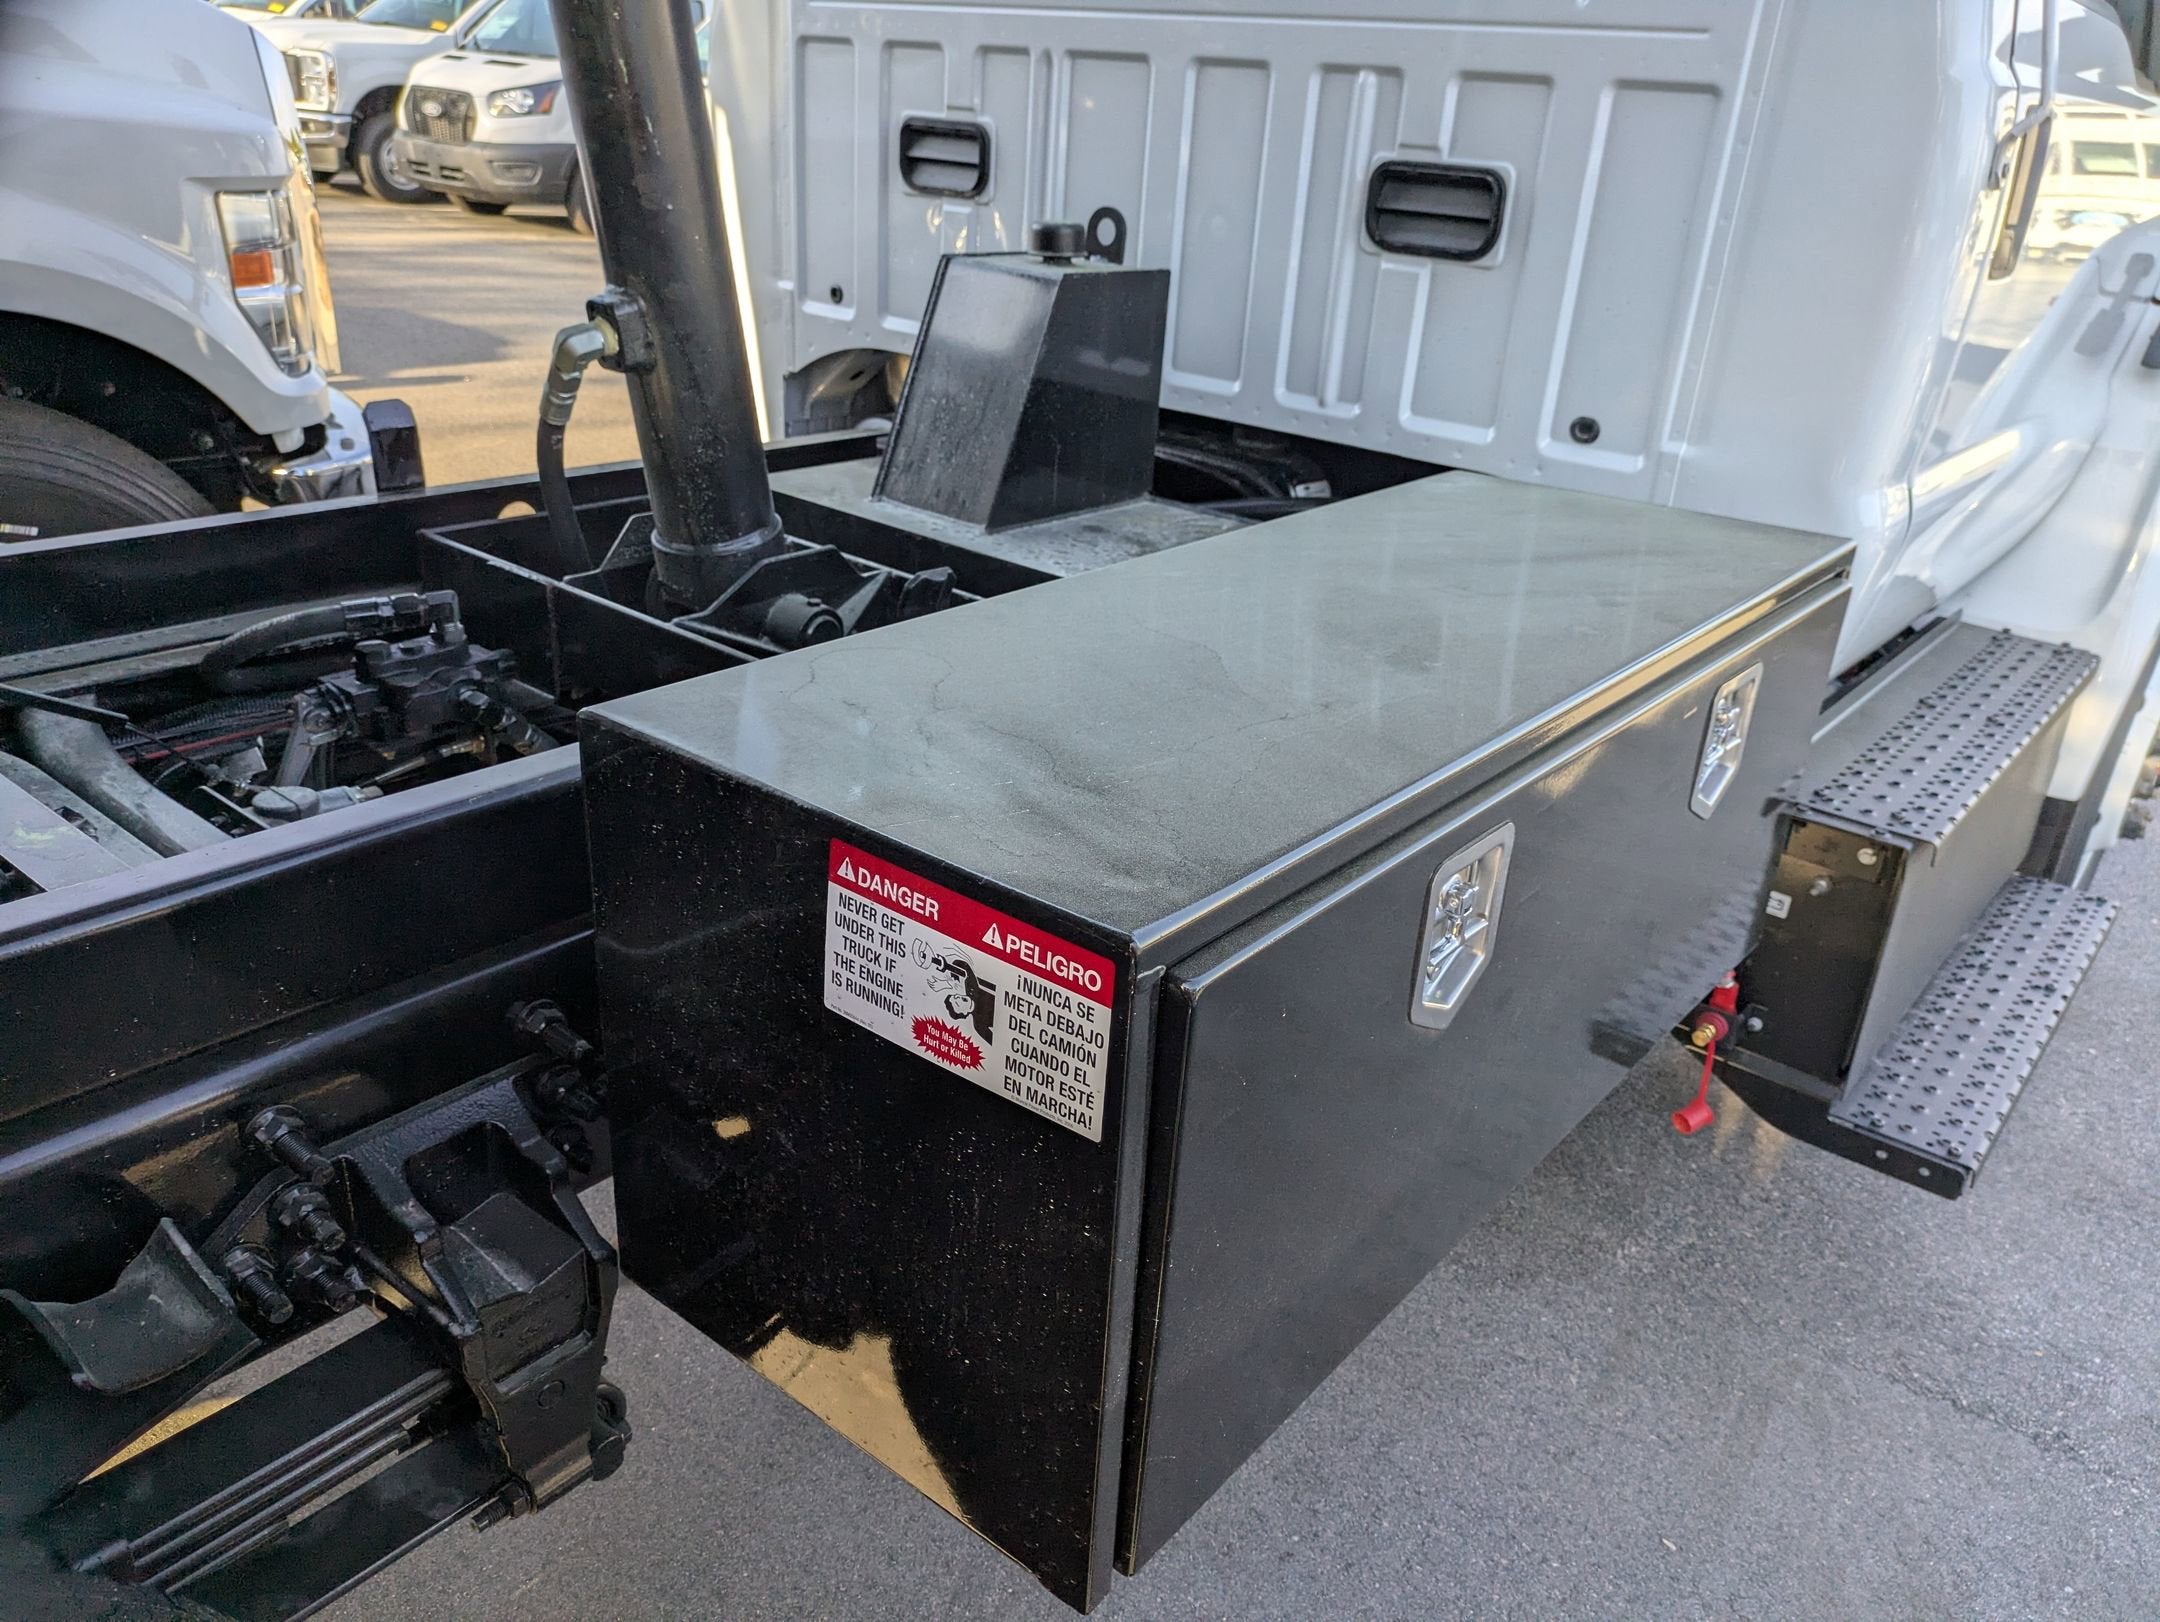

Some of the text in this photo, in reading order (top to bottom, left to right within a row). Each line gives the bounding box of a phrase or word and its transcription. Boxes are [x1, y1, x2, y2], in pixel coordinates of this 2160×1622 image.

[839, 892, 905, 935] NEVER GET
[858, 866, 939, 921] DANGER
[835, 911, 906, 958] UNDER THIS
[842, 935, 897, 973] TRUCK IF
[833, 951, 903, 999] THE ENGINE
[1006, 933, 1102, 992] PELIGRO
[831, 970, 842, 987] IS
[846, 977, 904, 1019] RUNNING!
[1017, 974, 1095, 1023] ¡NUNCA SE
[926, 1023, 969, 1051] You May Be
[1004, 990, 1104, 1049] META DEBAJO
[1009, 1014, 1097, 1069] DEL CAMIÓN
[923, 1034, 971, 1064] Hurt or Killed
[1011, 1037, 1090, 1087] CUANDO EL
[1004, 1075, 1021, 1097] EN
[1026, 1085, 1092, 1131] MARCHA!
[1005, 1055, 1095, 1111] MOTOR ESTÉ
